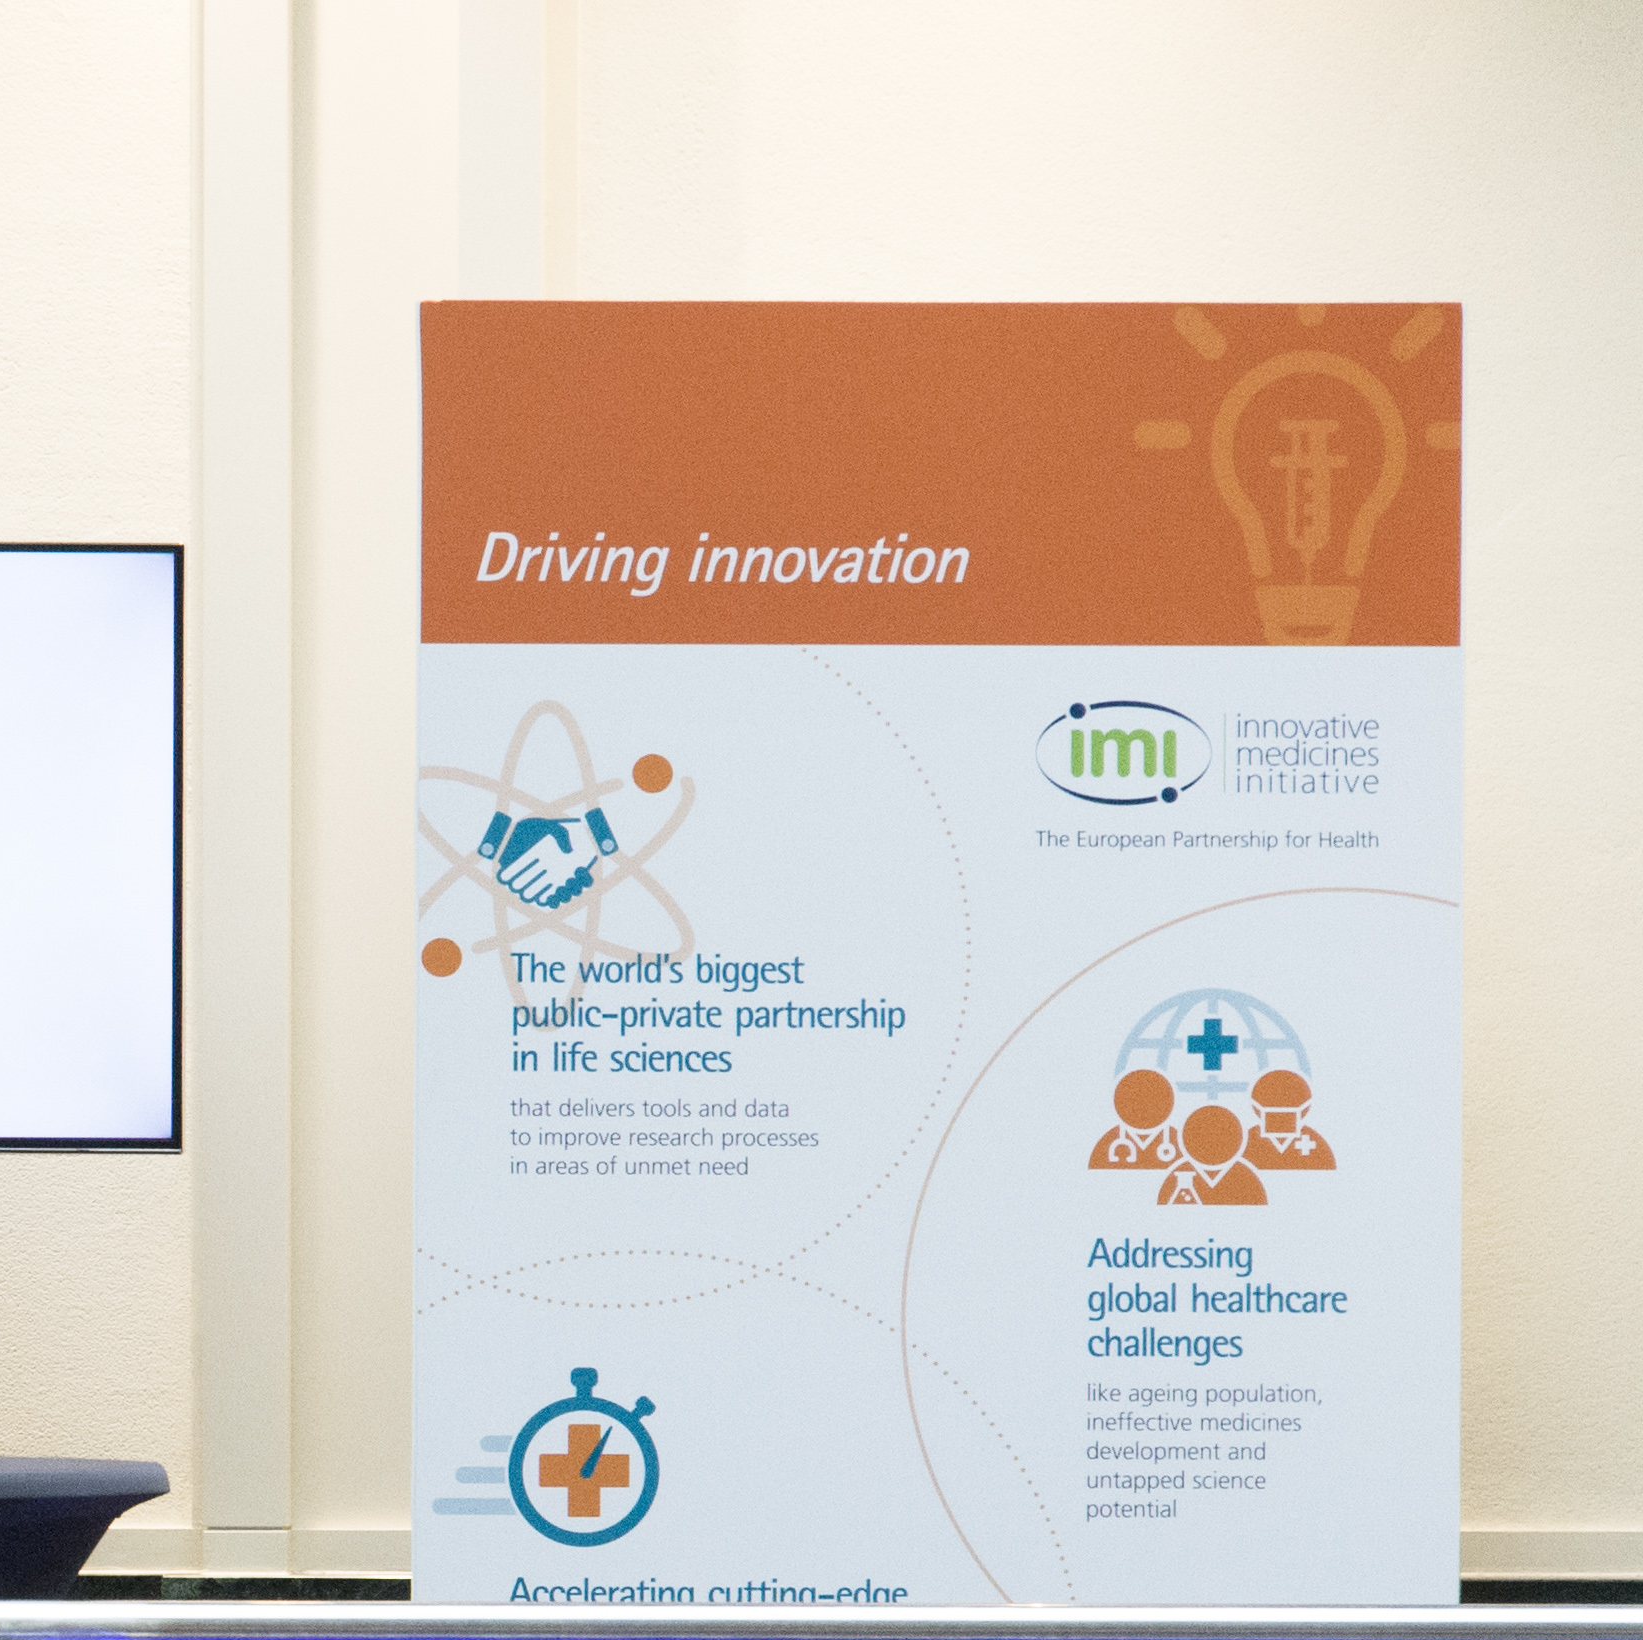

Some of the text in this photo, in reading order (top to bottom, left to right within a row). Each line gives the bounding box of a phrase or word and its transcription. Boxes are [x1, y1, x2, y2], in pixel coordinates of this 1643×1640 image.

[477, 531, 969, 597] Driving innovation
[1237, 712, 1379, 739] innovative
[1236, 740, 1379, 767] medicines
[1236, 769, 1379, 795] initiative
[1036, 829, 1379, 852] The European Partnership for Health
[510, 952, 804, 993] The world's biggest
[512, 997, 905, 1037] public-private partnership
[513, 1041, 732, 1073] in life sciences
[510, 1097, 789, 1119] that delivers tools and data
[510, 1127, 819, 1151] to improve research processes
[510, 1155, 749, 1176] in areas of unmet need
[1087, 1237, 1252, 1277] Addressing
[1087, 1282, 1347, 1322] global healthcare
[1087, 1326, 1243, 1367] challenges
[1087, 1383, 1322, 1407] like ageing population,
[1086, 1411, 1302, 1432] ineffective medicines
[1086, 1440, 1266, 1464] development and
[1086, 1470, 1266, 1494] untapped science
[1086, 1498, 1177, 1523] potential
